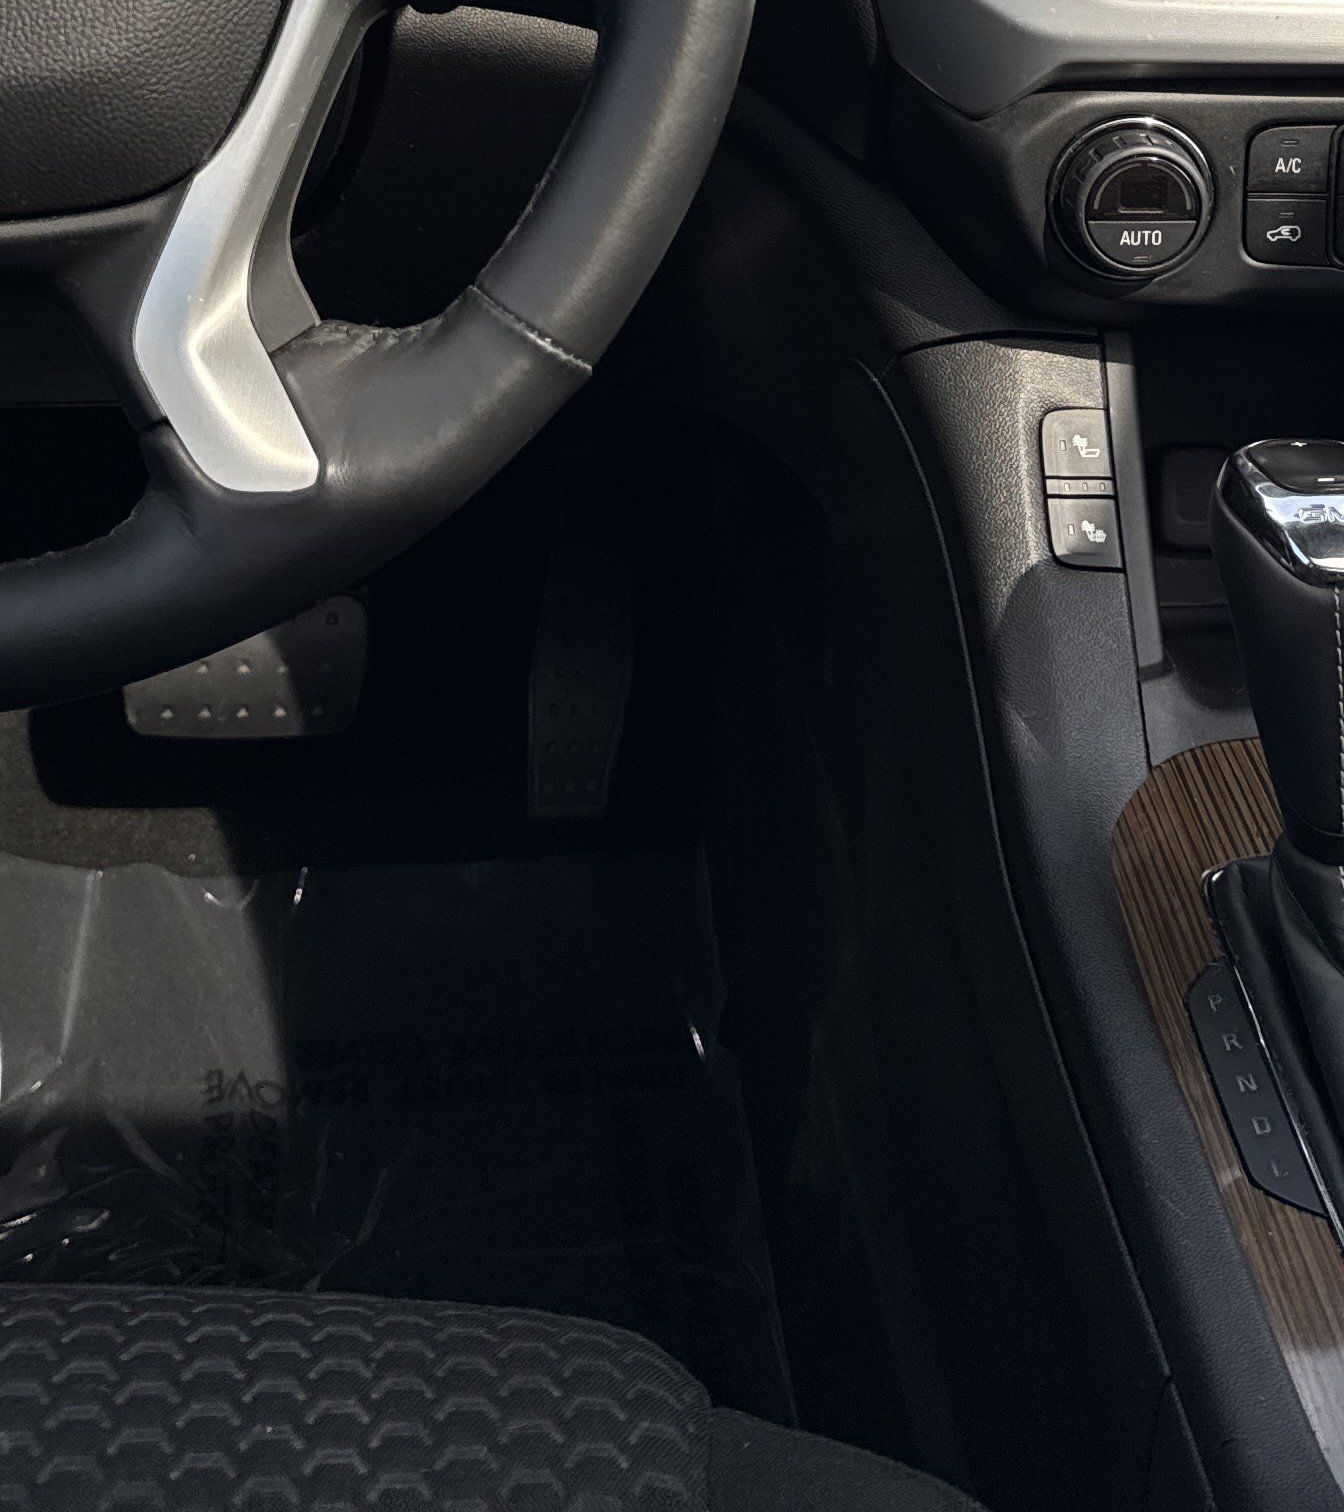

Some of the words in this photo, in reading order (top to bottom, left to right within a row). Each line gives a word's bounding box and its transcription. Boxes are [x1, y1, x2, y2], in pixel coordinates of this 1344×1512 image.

[1274, 157, 1303, 174] A/C
[1119, 229, 1162, 246] AUTO
[1207, 993, 1223, 1014] P
[1222, 1033, 1244, 1051] R
[1236, 1074, 1258, 1092] N
[1251, 1117, 1272, 1135] D
[1269, 1160, 1289, 1178] L
